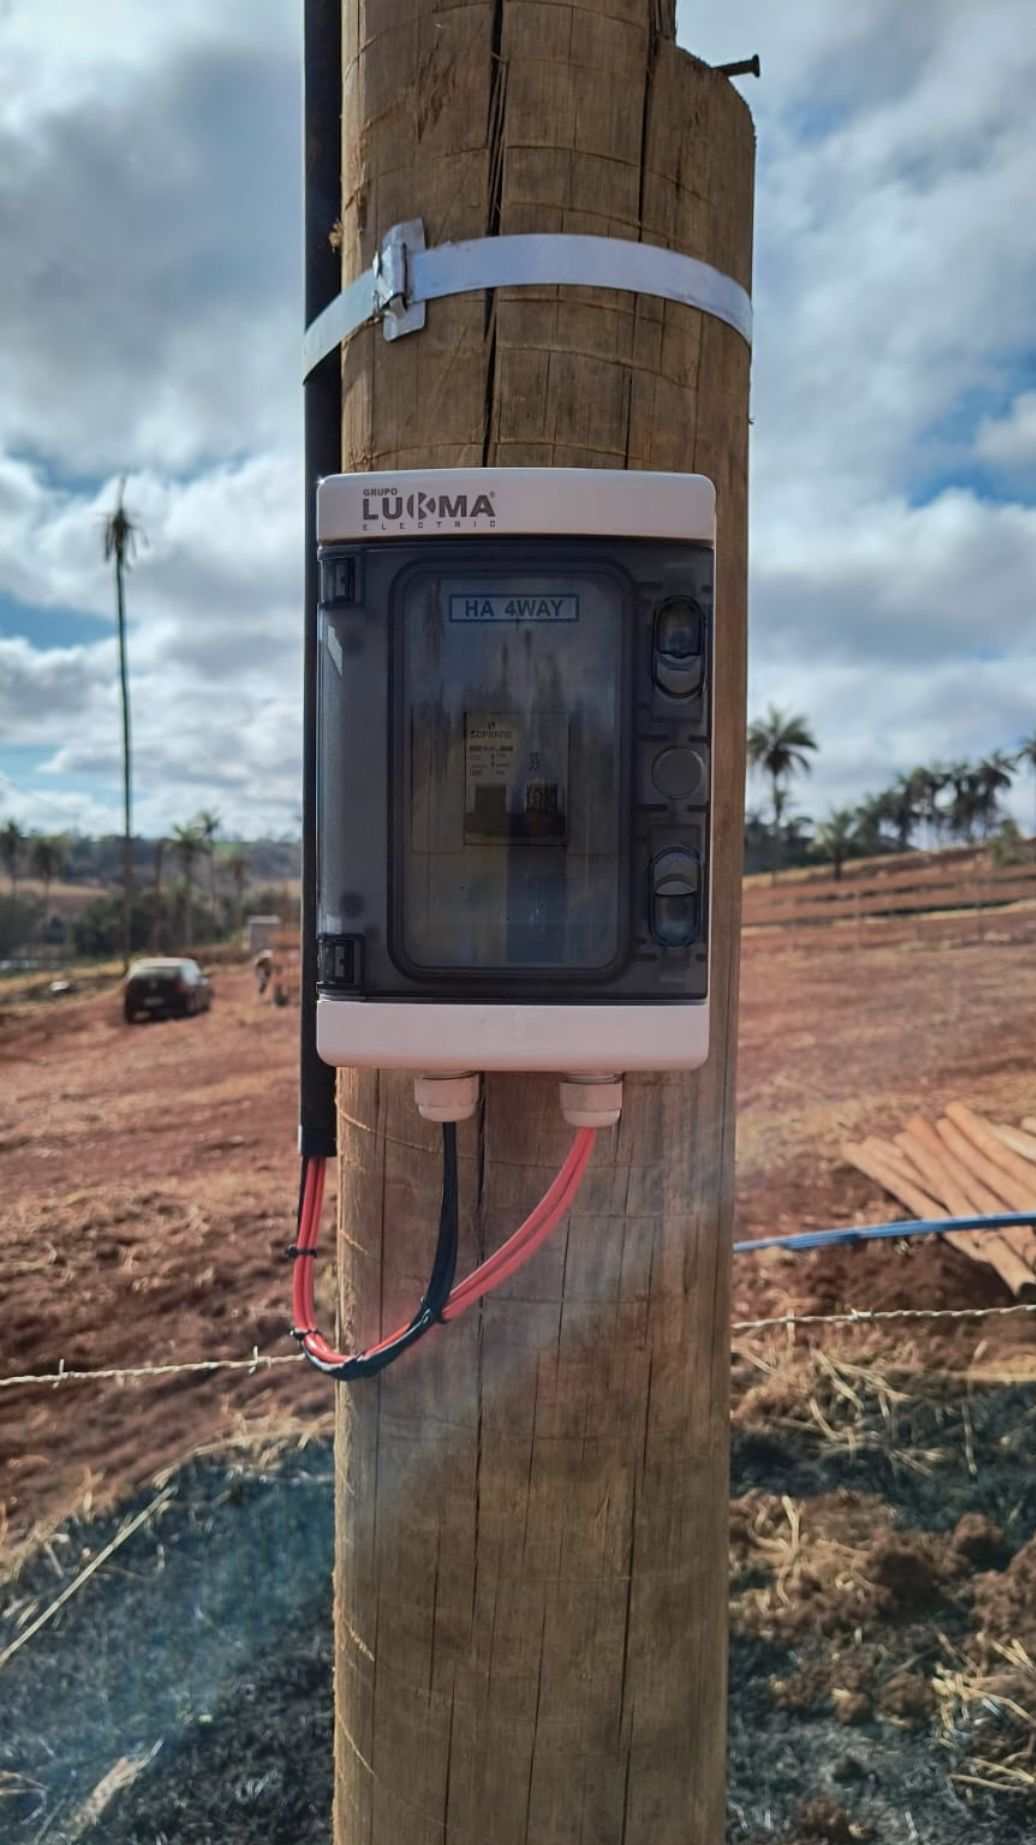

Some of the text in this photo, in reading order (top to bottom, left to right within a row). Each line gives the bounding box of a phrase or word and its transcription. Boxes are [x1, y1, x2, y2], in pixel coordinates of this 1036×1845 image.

[363, 488, 398, 496] GRUPO
[465, 600, 563, 617] HA 4WAY
